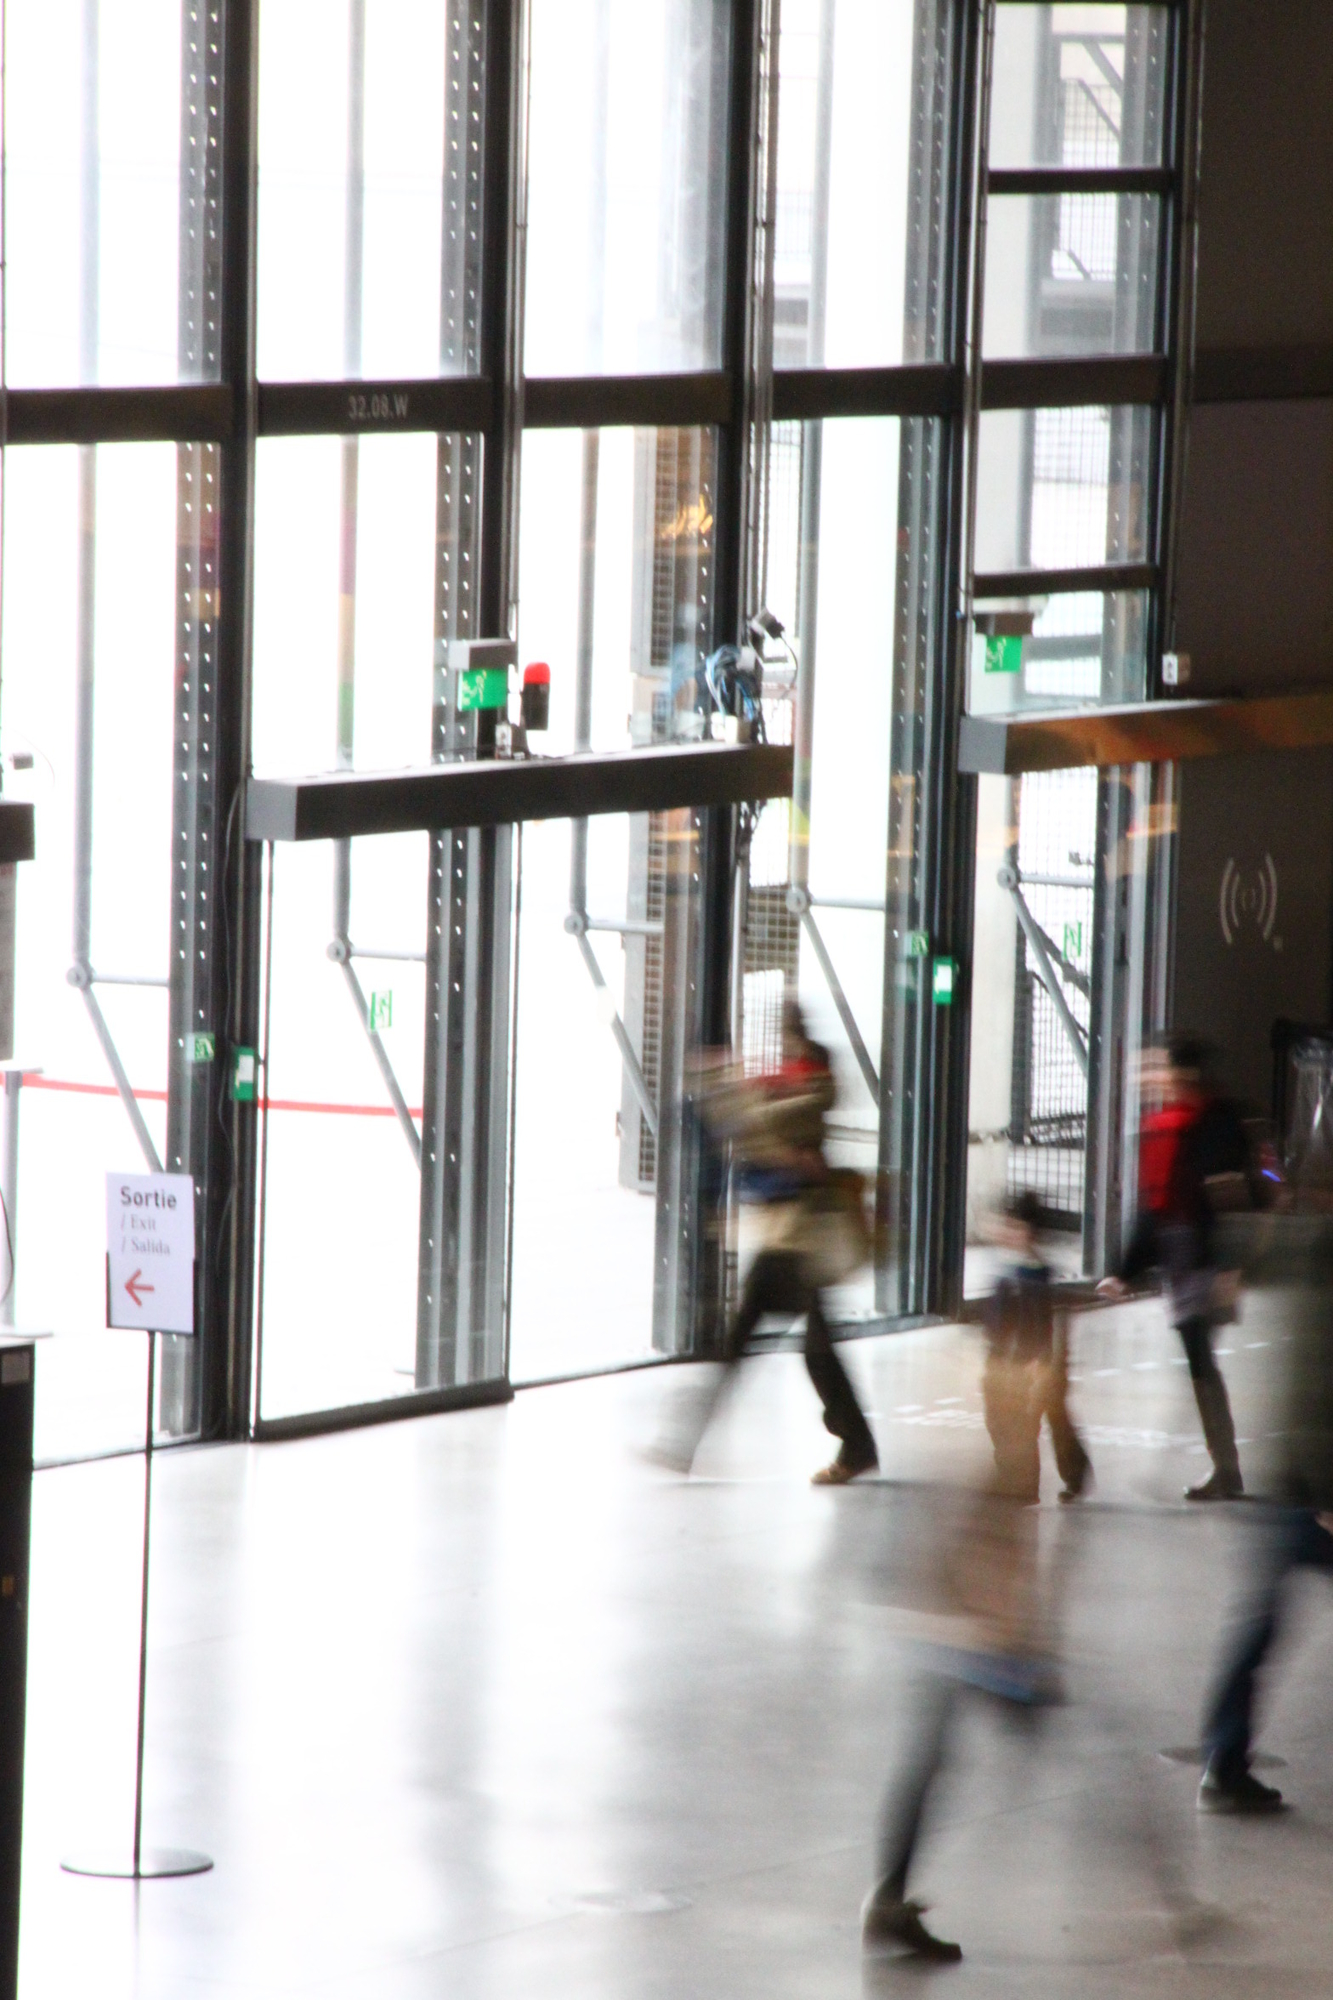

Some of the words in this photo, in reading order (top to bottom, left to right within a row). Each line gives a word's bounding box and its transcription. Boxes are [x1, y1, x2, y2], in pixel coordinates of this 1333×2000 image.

[120, 1185, 177, 1210] Sortie
[131, 1214, 156, 1231] Exit
[131, 1237, 170, 1255] Salida
